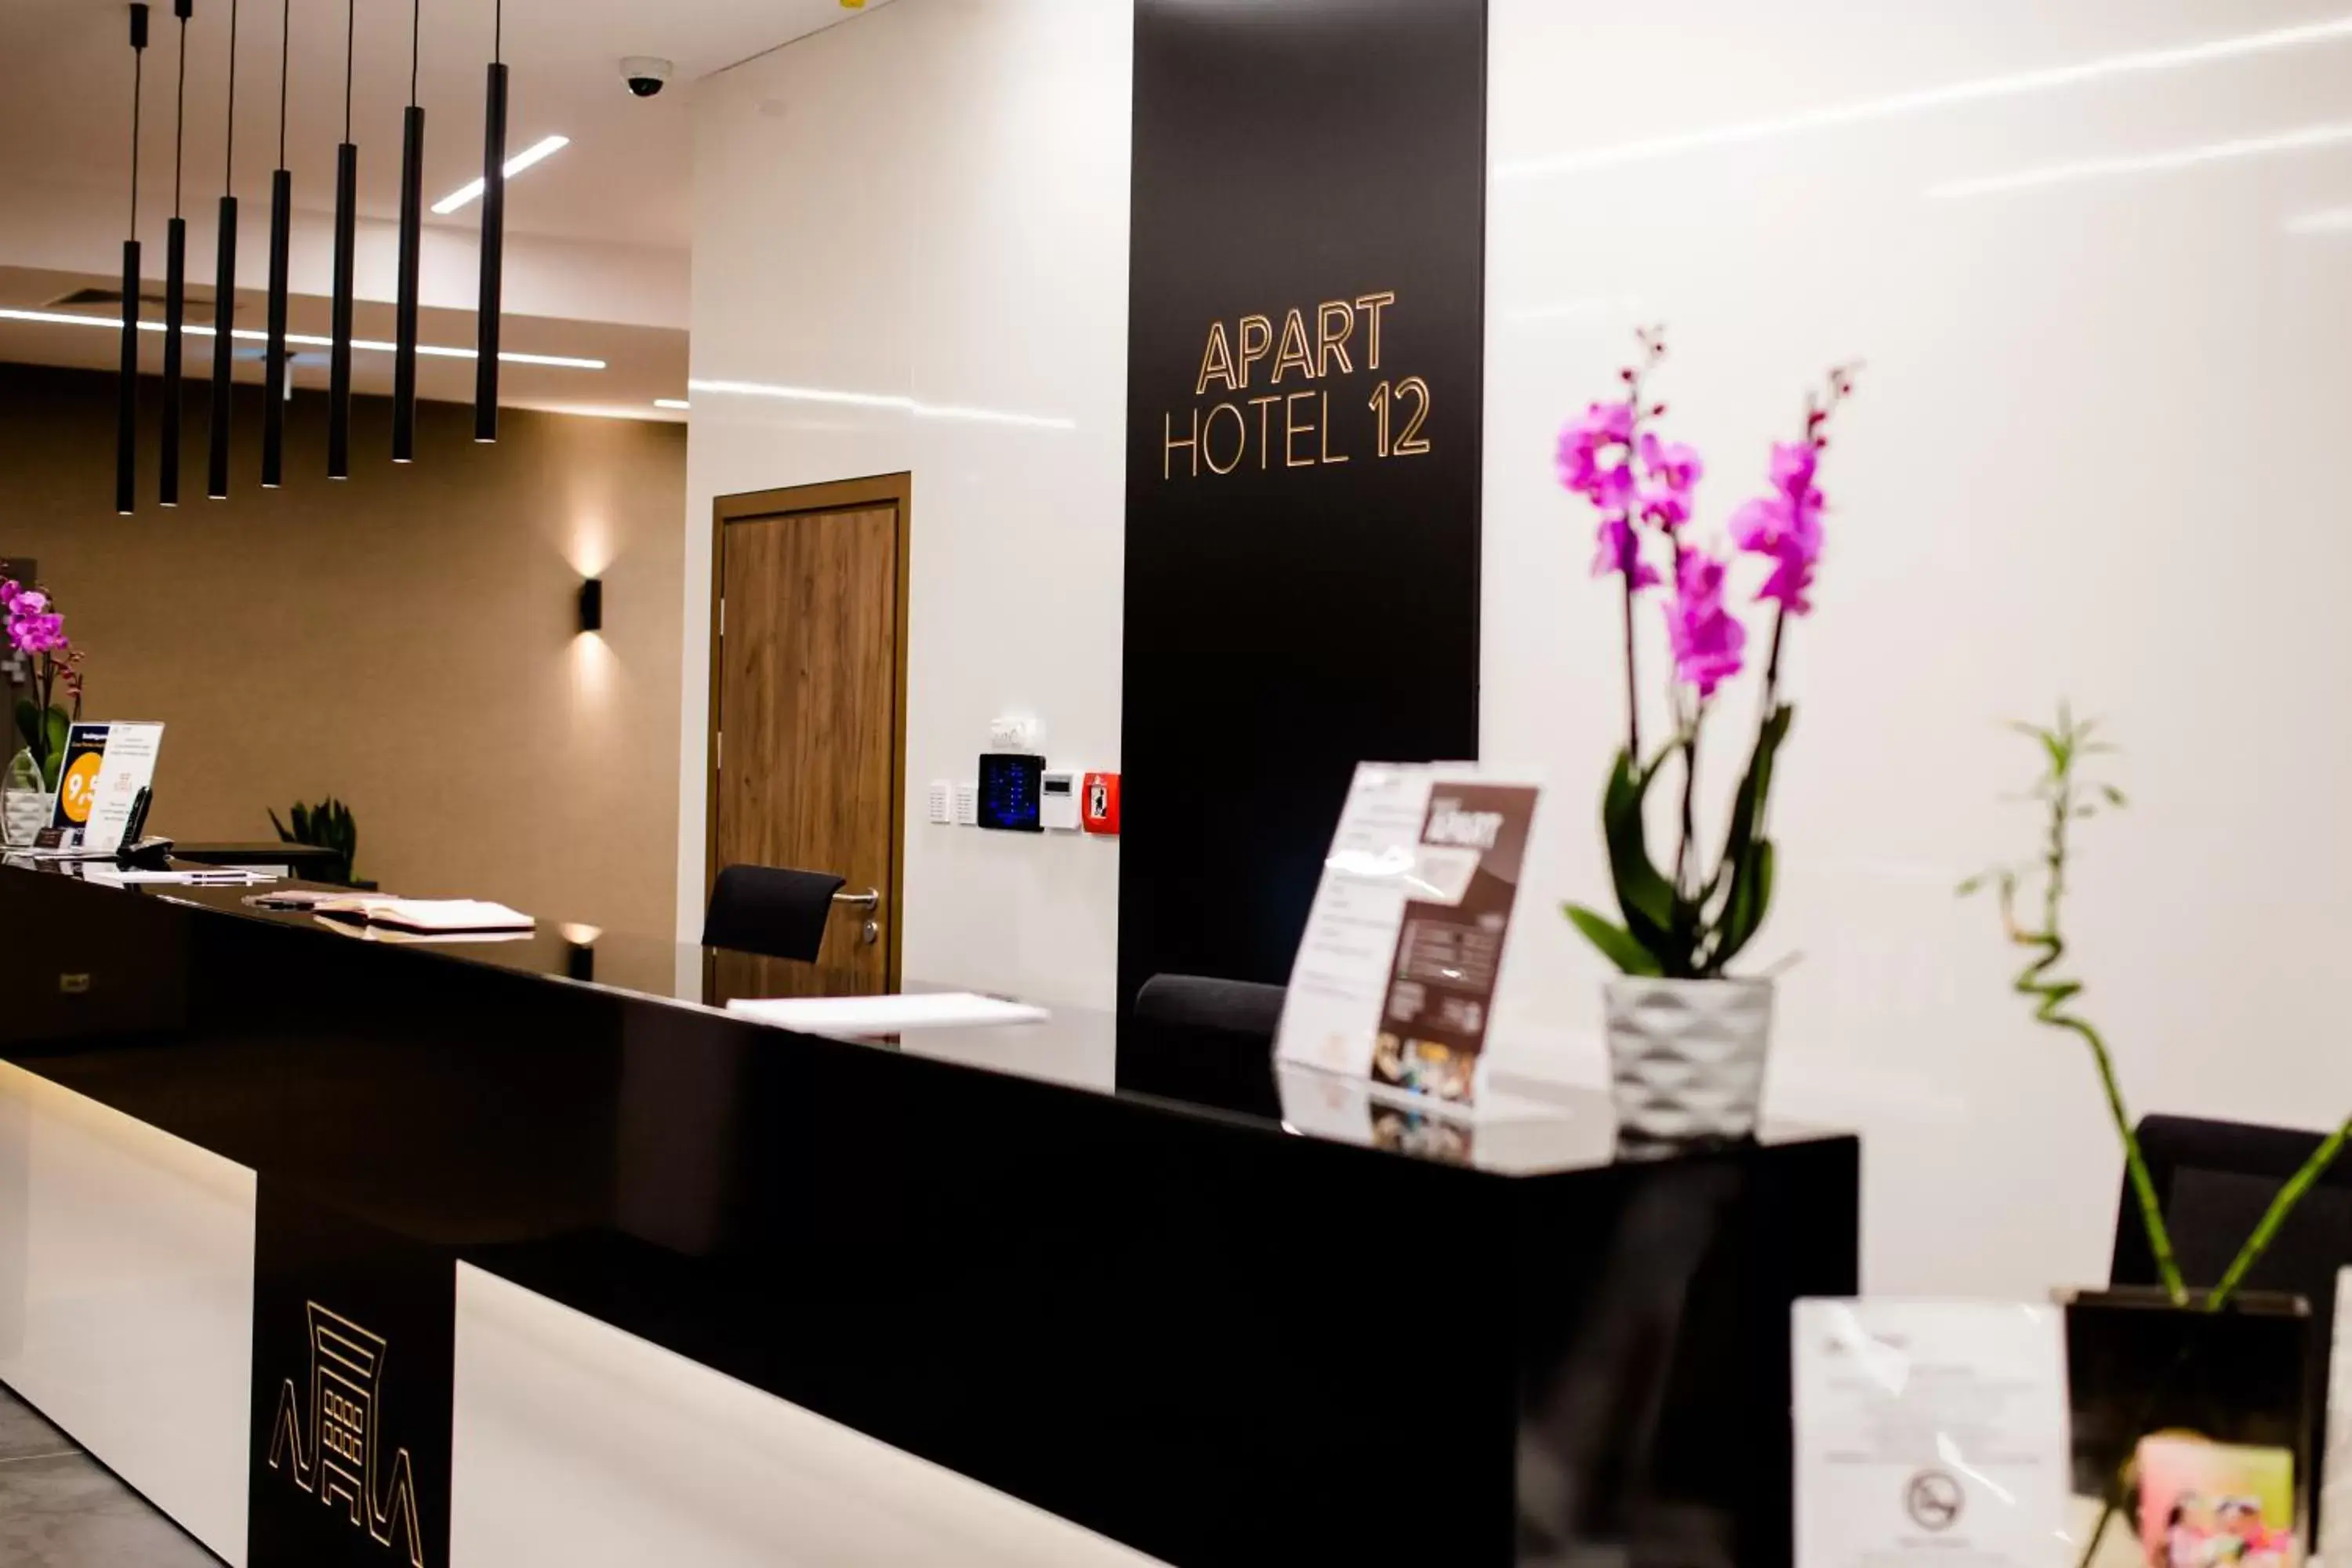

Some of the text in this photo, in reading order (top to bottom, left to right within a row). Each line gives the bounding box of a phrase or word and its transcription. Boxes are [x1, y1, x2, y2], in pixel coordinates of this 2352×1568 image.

[1196, 291, 1395, 394] APART
[1164, 376, 1431, 480] HOTEL 12
